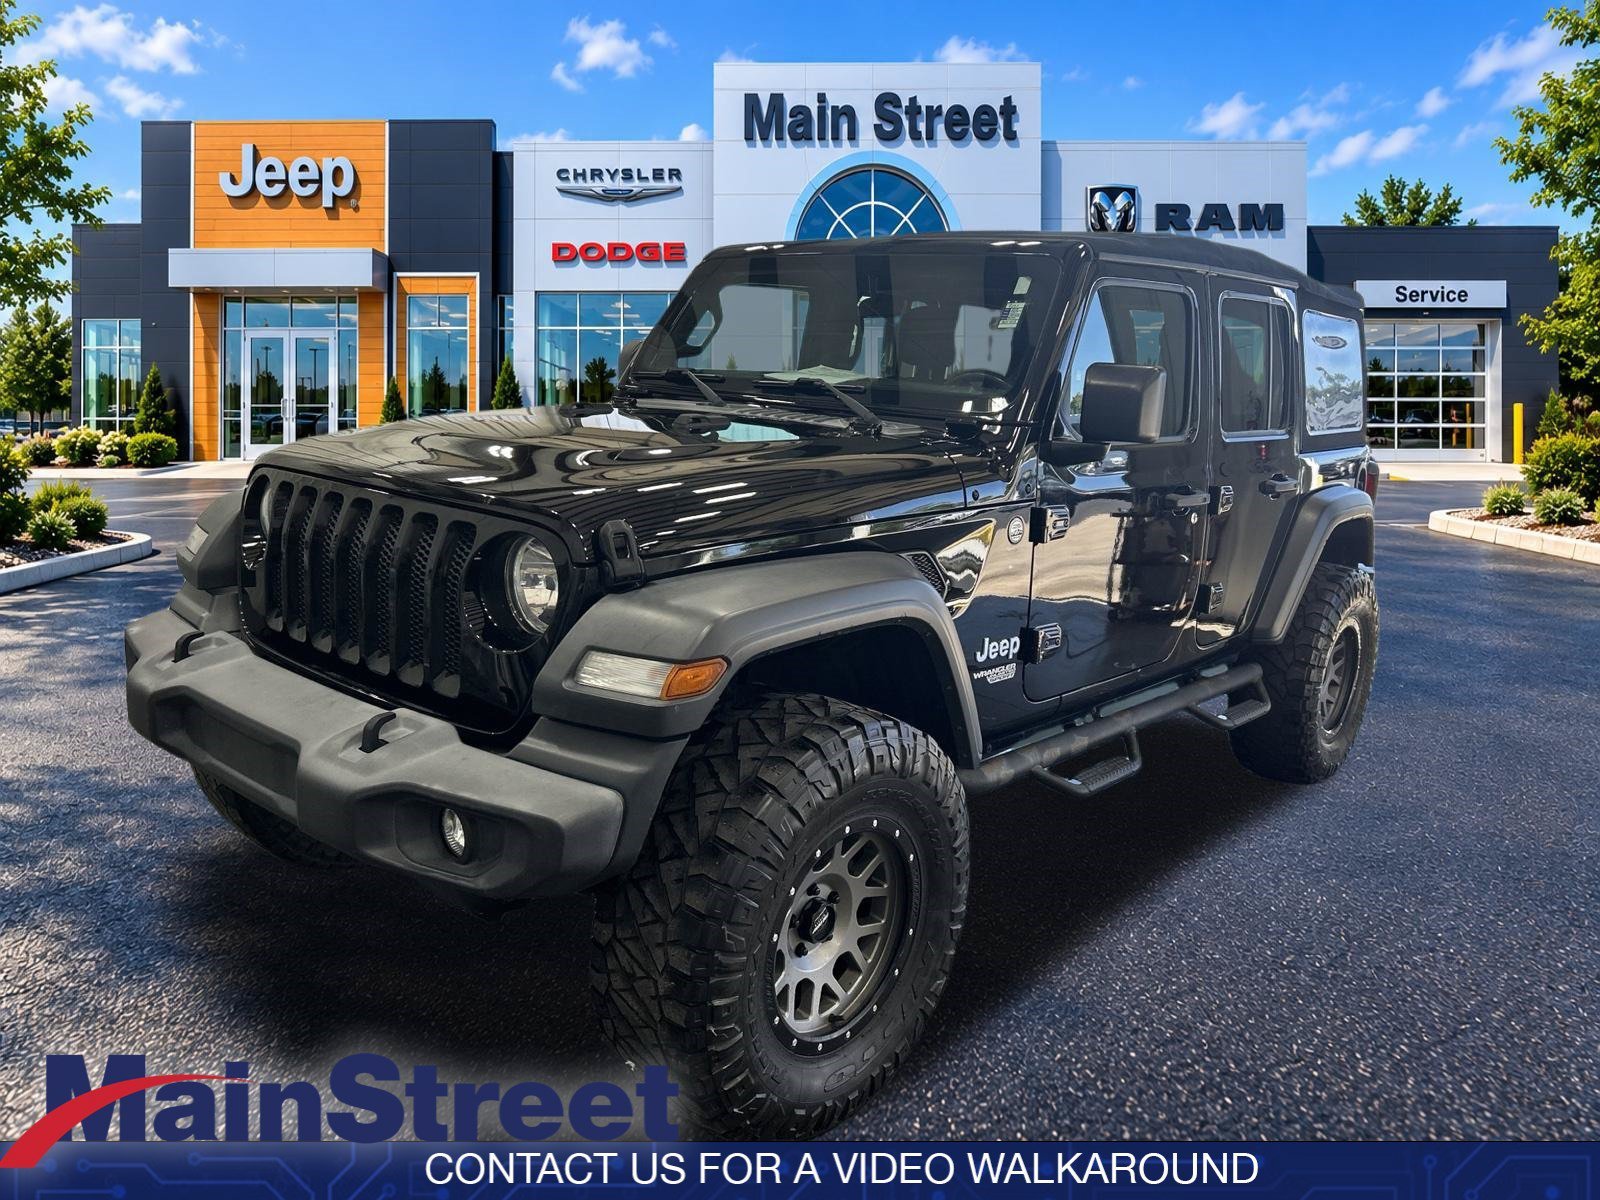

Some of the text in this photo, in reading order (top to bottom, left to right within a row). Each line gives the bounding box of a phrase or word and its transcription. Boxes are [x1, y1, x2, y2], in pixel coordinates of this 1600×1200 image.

[743, 91, 1018, 142] Main Street
[218, 143, 355, 208] Jeep
[556, 168, 682, 182] CHRYSLER
[1154, 203, 1284, 231] RAM
[551, 242, 687, 262] DODGE
[1395, 285, 1469, 303] Service
[976, 636, 1020, 662] Jeep
